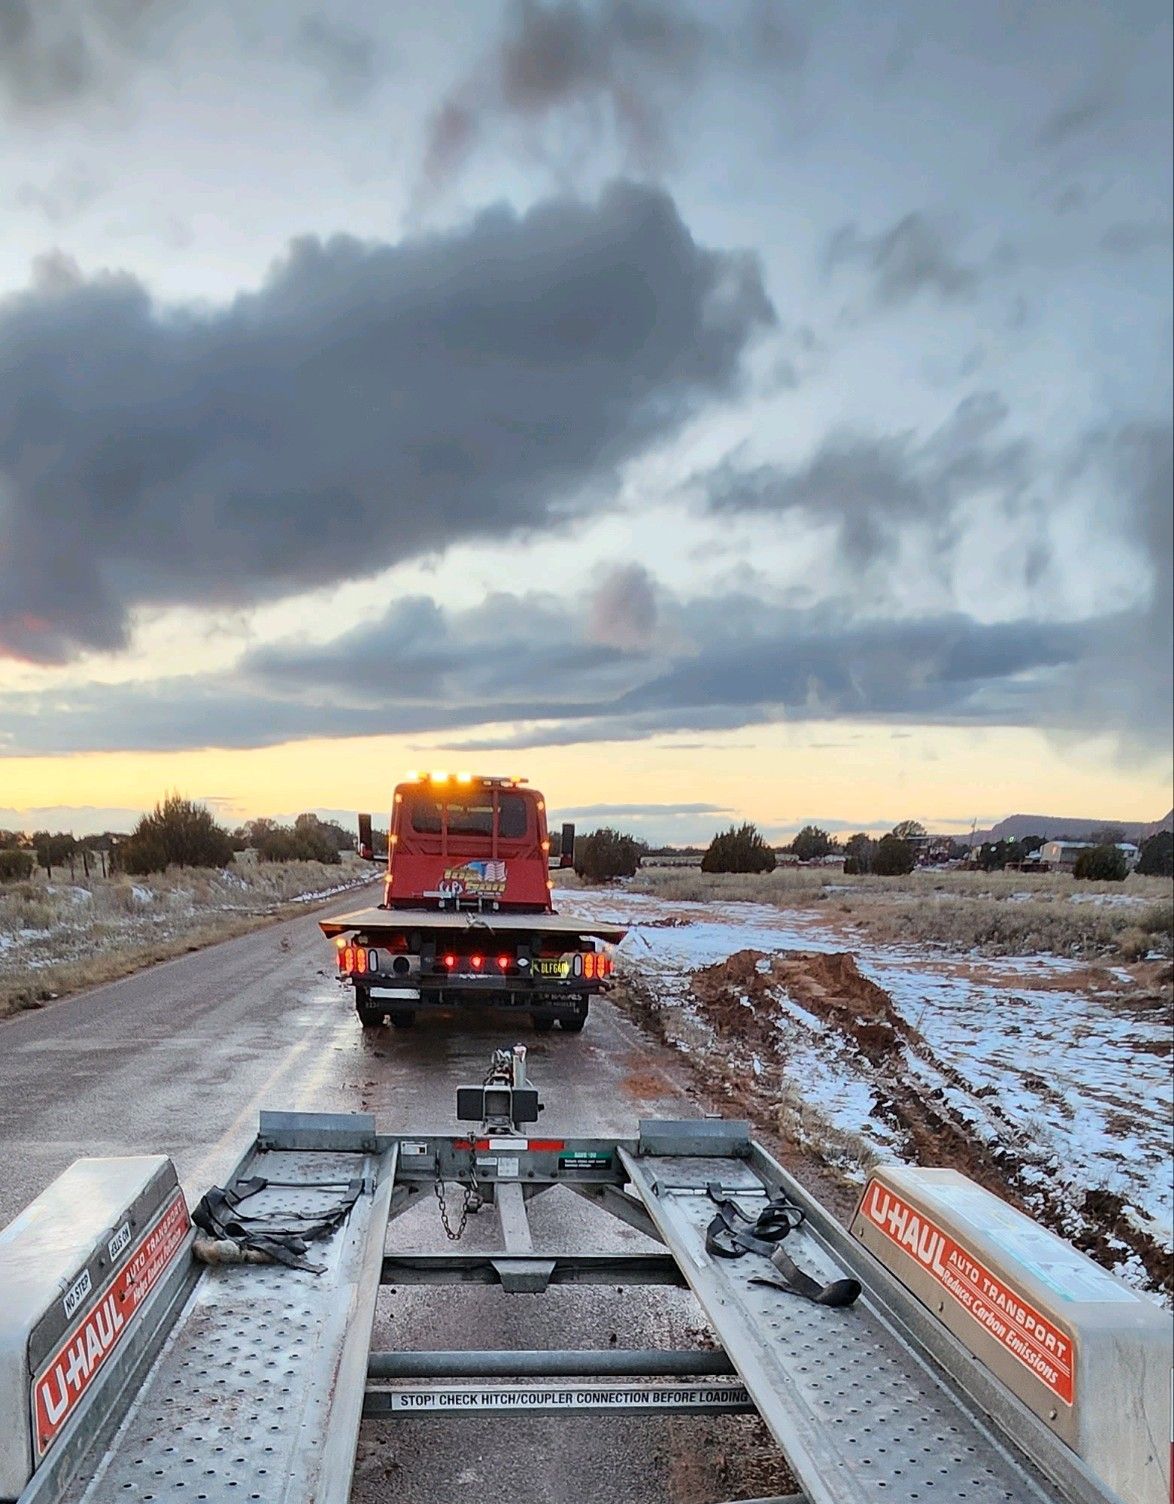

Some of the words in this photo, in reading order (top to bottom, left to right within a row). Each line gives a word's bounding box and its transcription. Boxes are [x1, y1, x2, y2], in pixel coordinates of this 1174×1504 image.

[126, 1253, 146, 1285] AUTO
[146, 1200, 182, 1254] TRANSPORT
[871, 1187, 946, 1276] U-HAUL
[65, 1293, 75, 1312] NO
[74, 1274, 89, 1300] STEP
[941, 1269, 974, 1306] Reduces
[972, 1300, 1007, 1338] Carbon
[1005, 1328, 1059, 1384] Emissions
[949, 1250, 979, 1283] AUTO
[983, 1278, 1066, 1358] TRANSPORT
[41, 1293, 125, 1425] U-HAUL
[401, 1394, 435, 1406] STOP!
[439, 1394, 478, 1405] CHECK
[481, 1393, 573, 1405] HITCH/COUPLER
[577, 1392, 650, 1404] CONNECTION
[653, 1392, 696, 1403] BEFORE
[700, 1391, 749, 1402] LOADING
